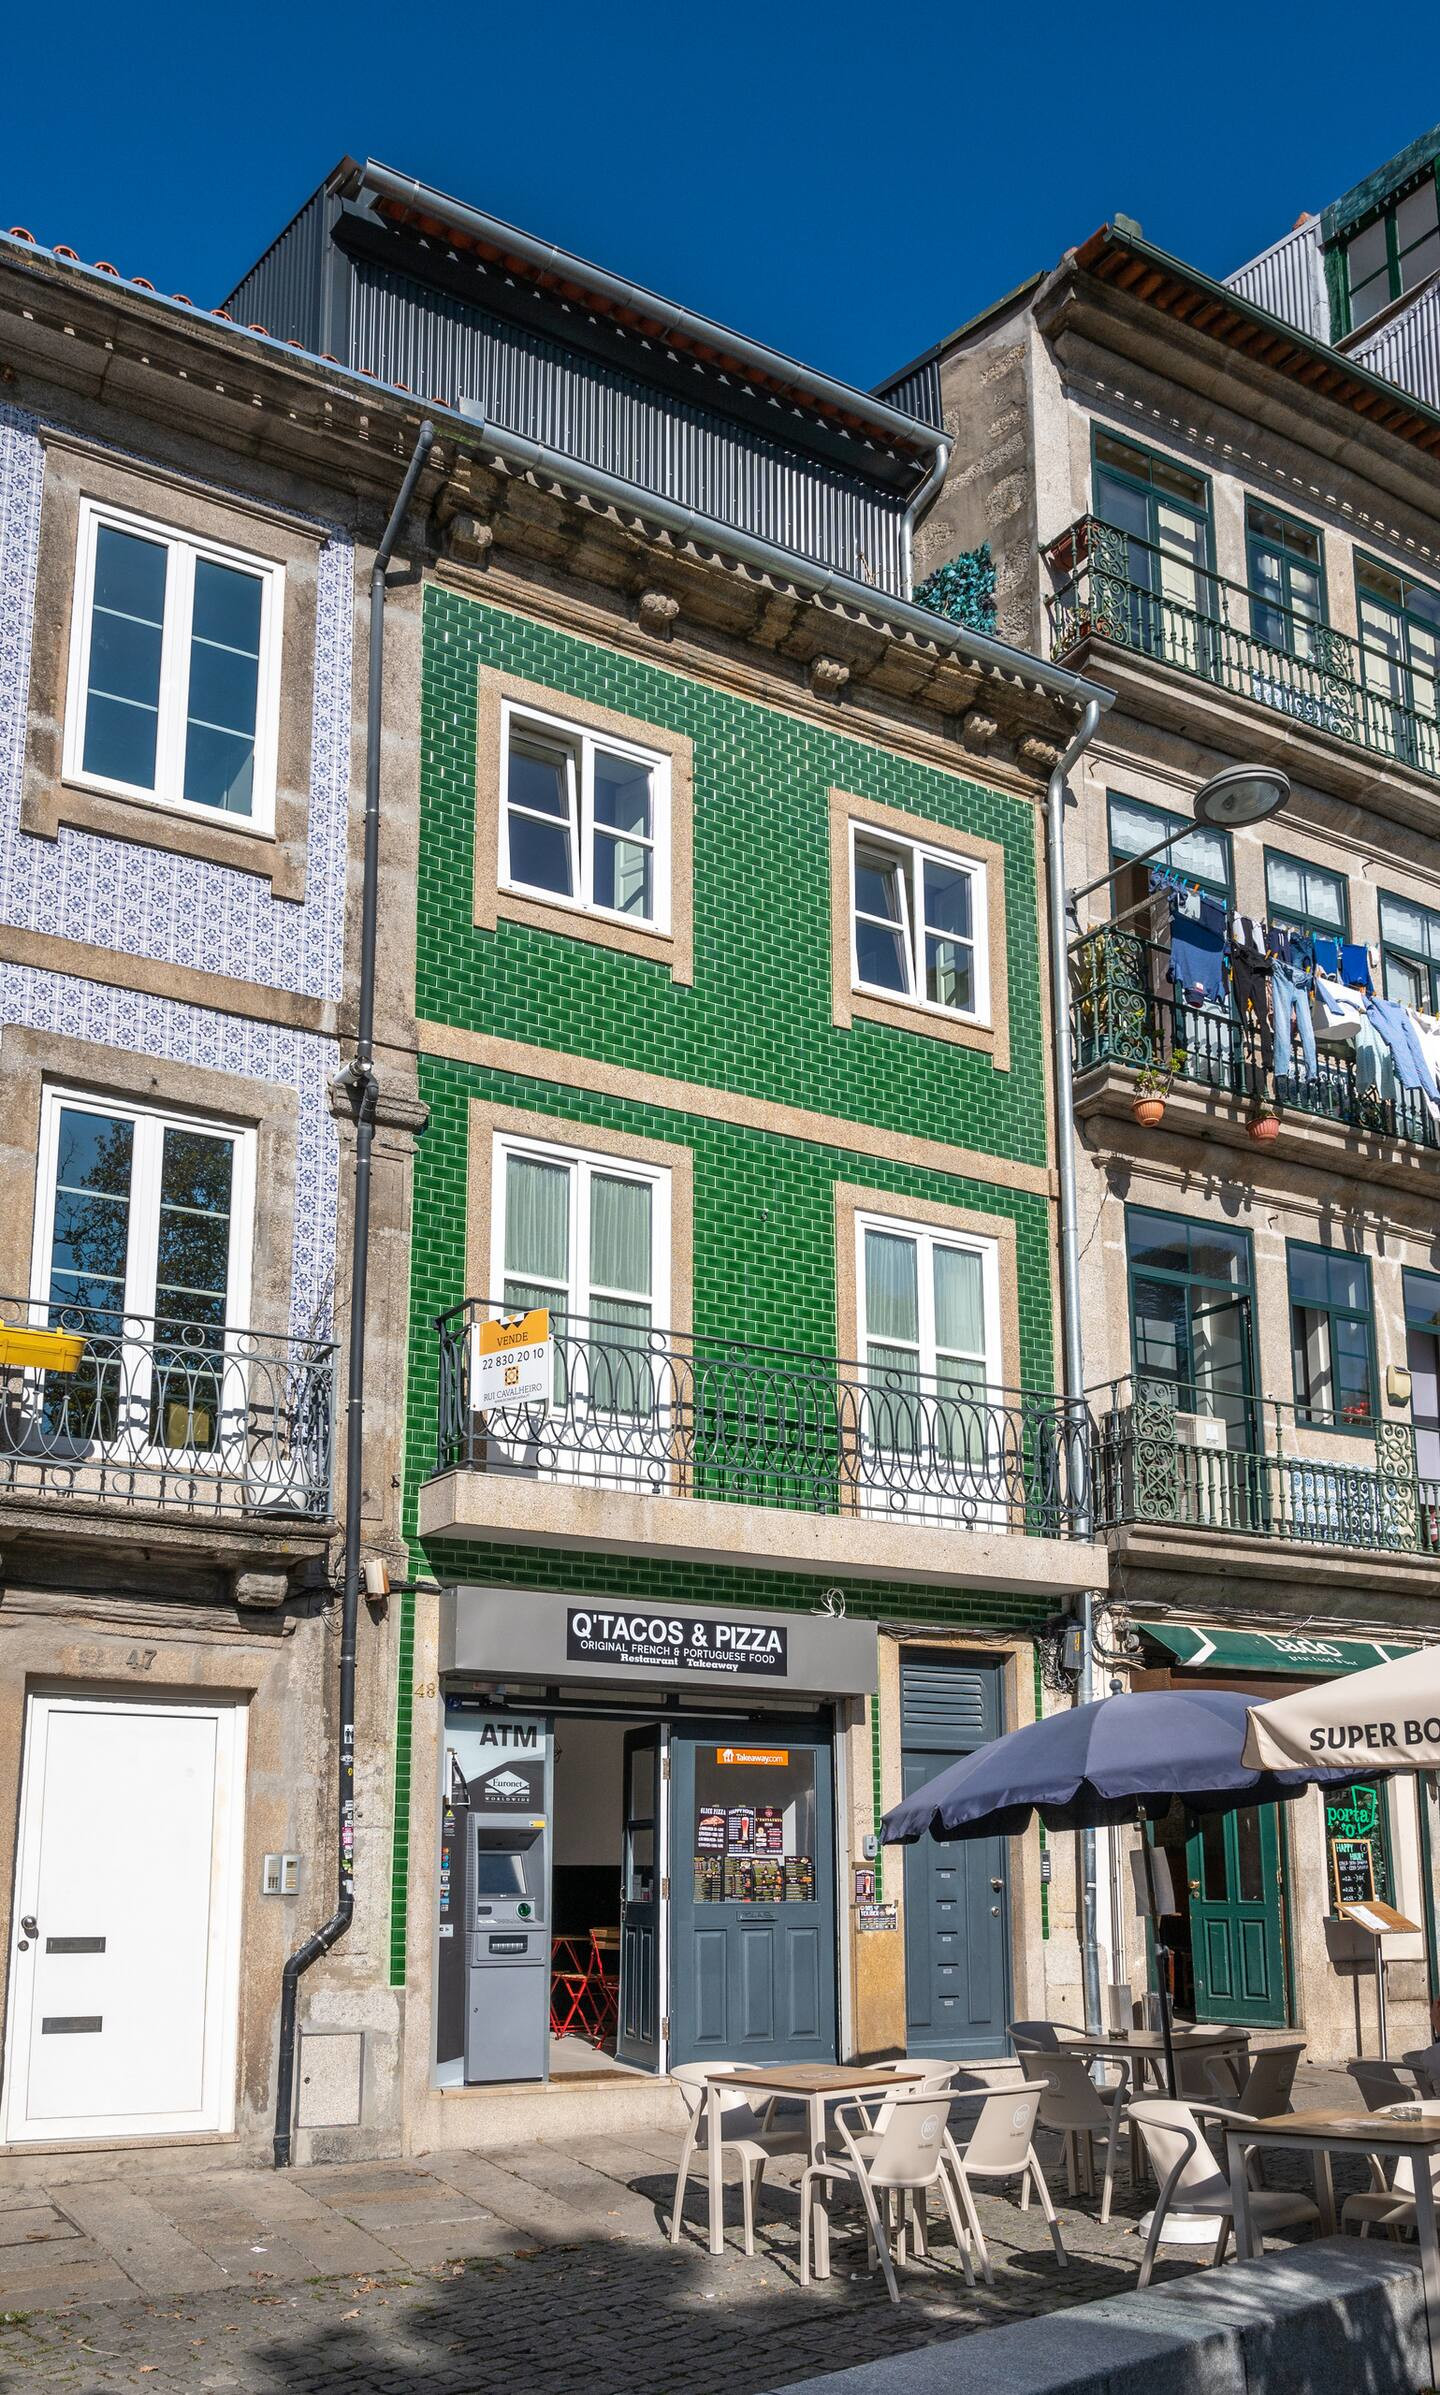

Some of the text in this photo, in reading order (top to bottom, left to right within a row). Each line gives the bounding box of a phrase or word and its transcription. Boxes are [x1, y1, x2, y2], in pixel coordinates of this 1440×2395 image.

[497, 1332, 529, 1346] VENDE
[483, 1348, 545, 1370] 22 830 20 10
[483, 1392, 495, 1402] RUI
[497, 1383, 543, 1399] CAVALHEIRO
[572, 1612, 783, 1654] Q'TACOS & PIZZA
[126, 1648, 158, 1670] 47
[580, 1640, 775, 1664] ORIGINAL FRENCH & PORTUGUESE FOOD
[620, 1653, 739, 1672] Restaurant Takeaway
[415, 1683, 435, 1698] 48
[480, 1724, 537, 1748] ATM
[1310, 1722, 1398, 1751] SUPER
[736, 1753, 783, 1765] Takeaway.com
[492, 1779, 523, 1787] Euronet
[1327, 1807, 1369, 1826] porta
[1336, 1843, 1354, 1853] HAPPY
